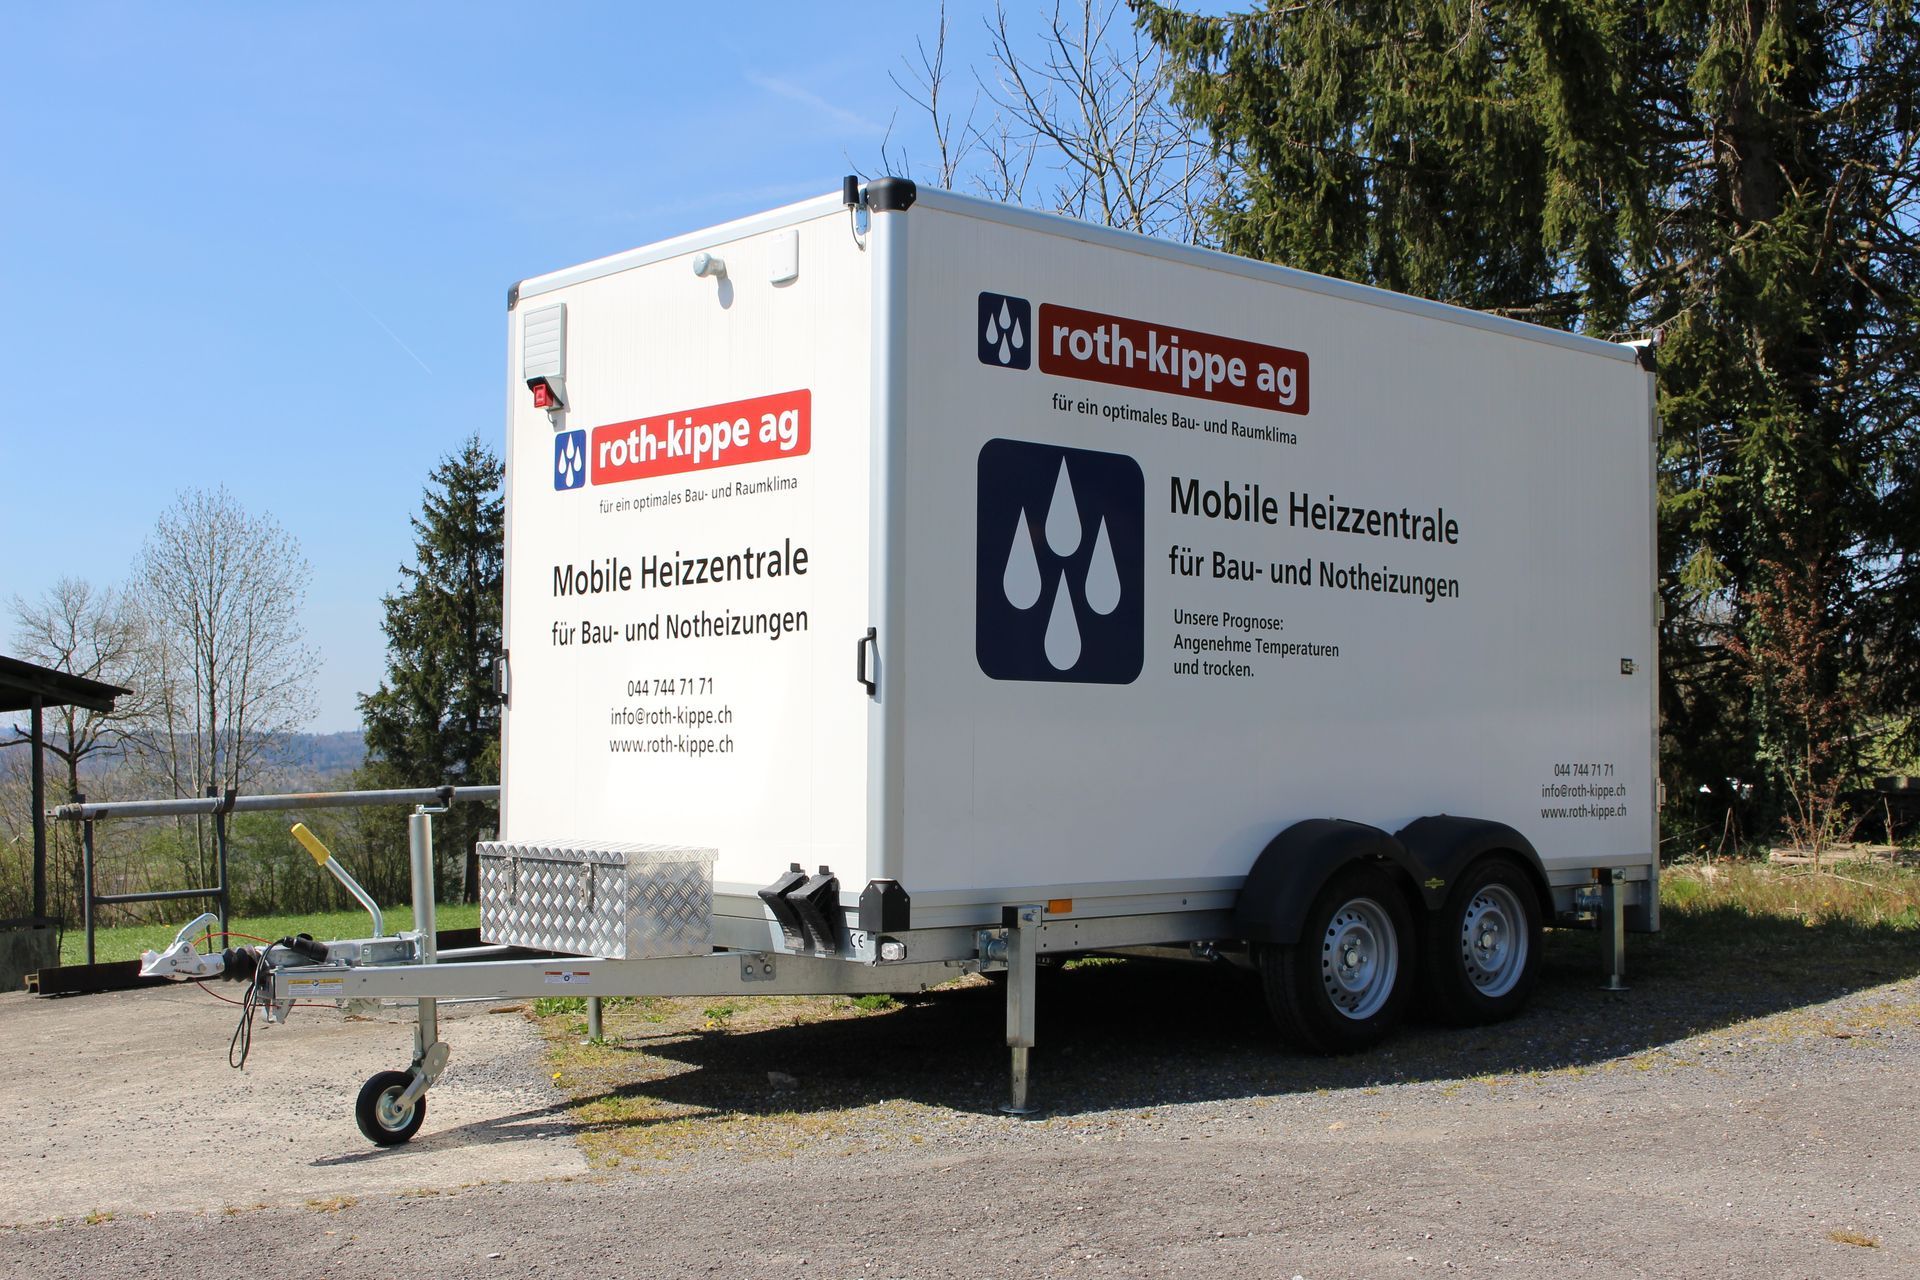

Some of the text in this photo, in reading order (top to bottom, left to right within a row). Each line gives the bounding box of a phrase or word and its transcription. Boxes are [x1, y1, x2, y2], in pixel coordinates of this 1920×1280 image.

[1052, 324, 1297, 405] roth-kippe ag
[1052, 393, 1296, 445] für ein optimales Bau- und Raumklima
[600, 409, 799, 468] roth-kippe ag
[600, 476, 797, 513] für ein optimales Bau- und Raumklima
[1171, 477, 1458, 544] Mobile Heizzentrale
[554, 538, 808, 597] Mobile Heizzentrale
[1169, 545, 1458, 603] für Bau- und Notheizungen
[552, 609, 807, 646] für Bau- und Notheizungen
[1175, 609, 1283, 632] Unsere Prognose:
[1174, 634, 1338, 658] Angenehme Temperaturen
[1174, 659, 1254, 677] und trocken.
[628, 678, 712, 696] 044 744 71 71
[612, 705, 732, 728] info@roth-kippe.ch
[610, 735, 733, 757] www.roth-kippe.ch
[1555, 764, 1613, 776] 044 744 71 71
[1542, 784, 1625, 800] info@roth-kippe.ch
[1541, 803, 1627, 820] www.roth-kippe.ch
